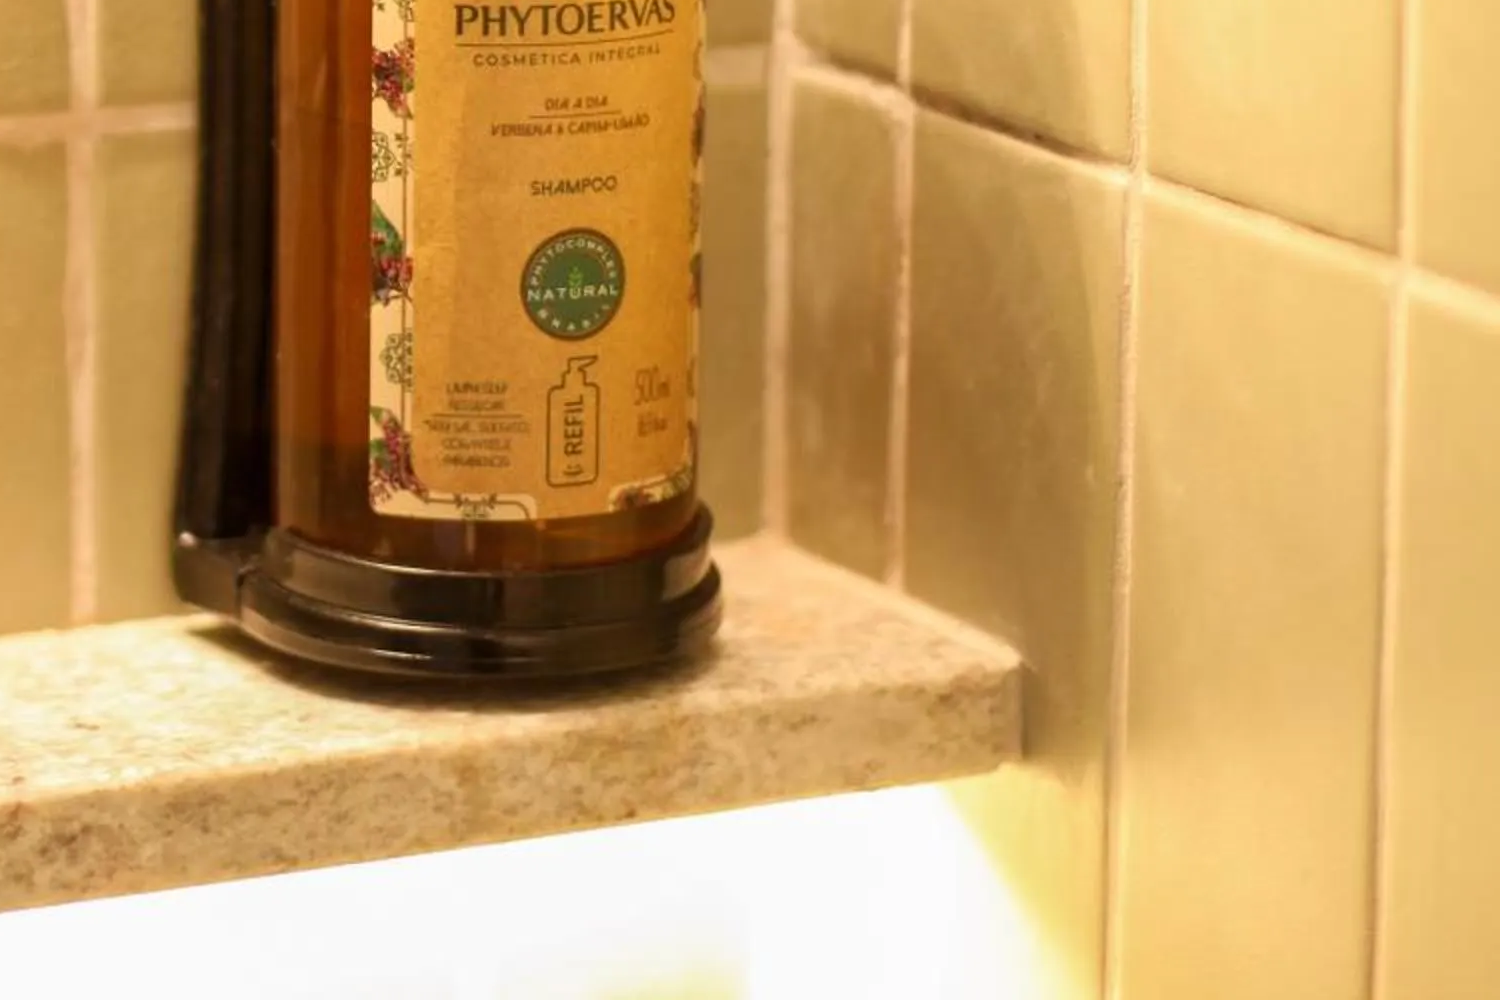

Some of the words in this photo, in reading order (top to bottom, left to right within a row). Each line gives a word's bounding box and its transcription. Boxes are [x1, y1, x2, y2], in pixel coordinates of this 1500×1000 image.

[531, 175, 618, 196] SHAMPOO
[527, 285, 618, 301] NATURAL
[563, 395, 584, 456] REFIL
